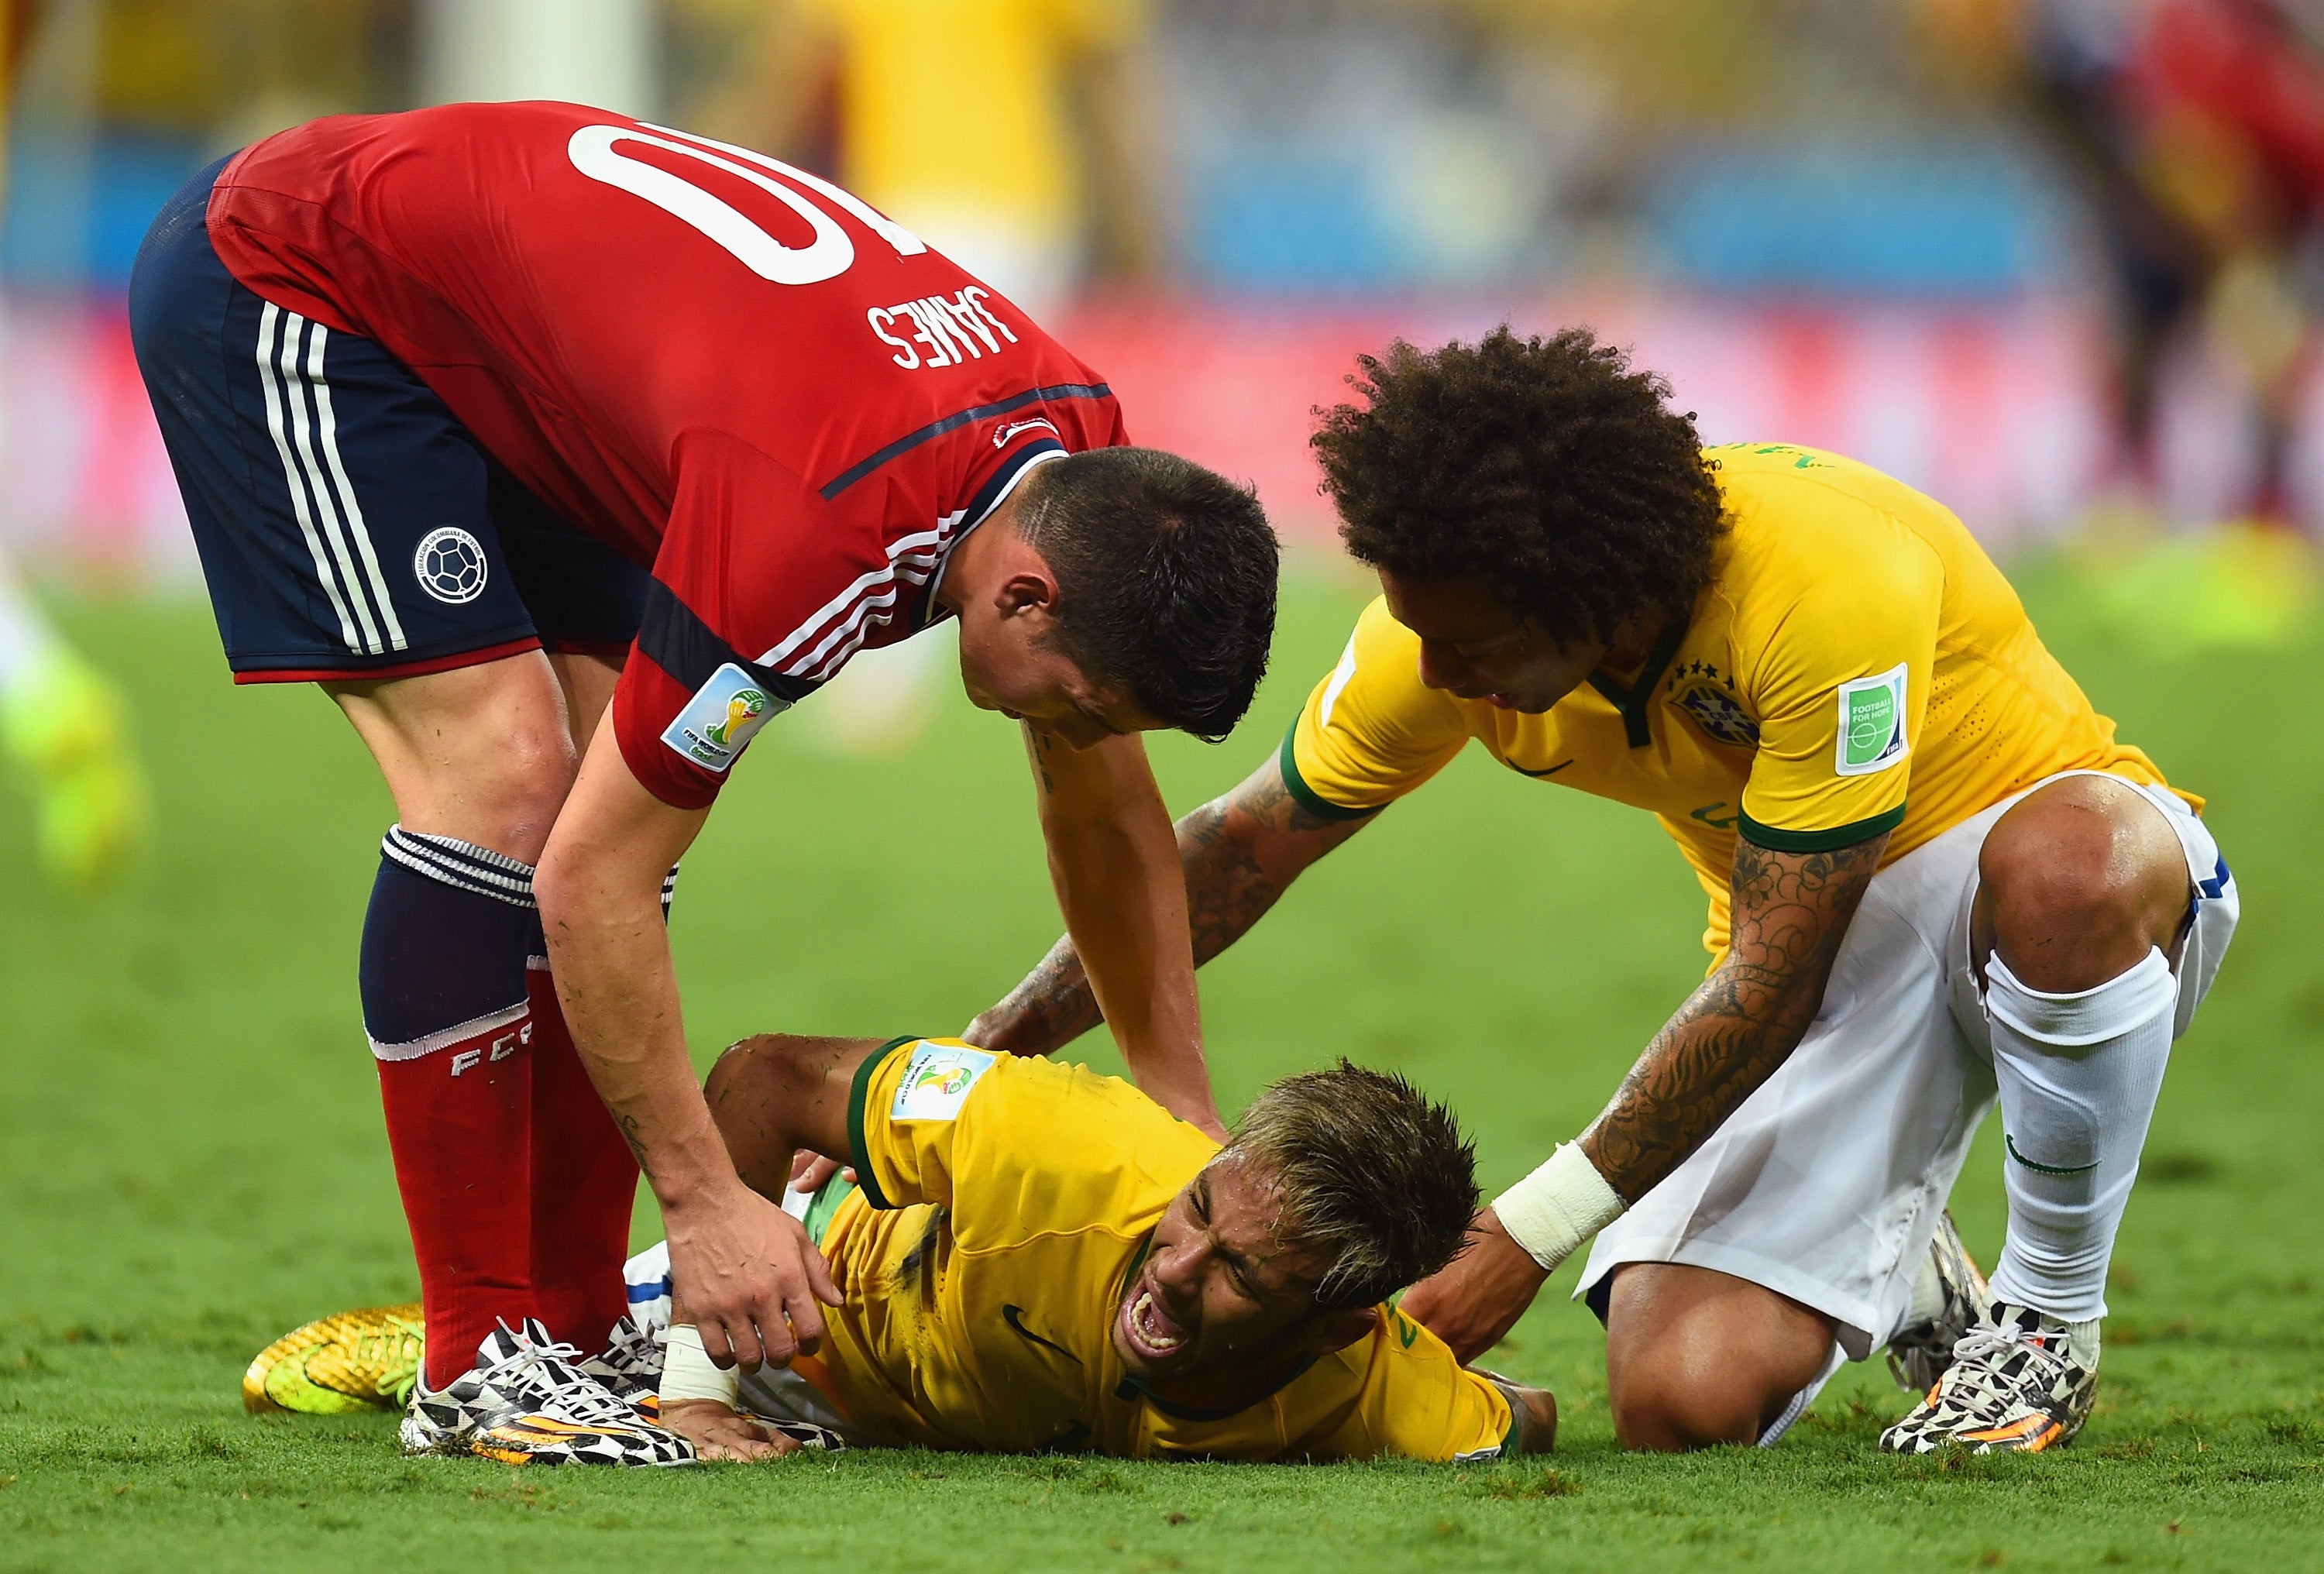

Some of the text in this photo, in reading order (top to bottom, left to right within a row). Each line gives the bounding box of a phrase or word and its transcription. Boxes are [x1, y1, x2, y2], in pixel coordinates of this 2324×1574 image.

[568, 121, 927, 286] 10
[867, 284, 1019, 370] JAMES
[1852, 698, 1892, 714] FOOTBALL
[1852, 706, 1890, 723] FOR HOPE
[683, 729, 699, 744] FIFA
[697, 738, 720, 755] WORLD
